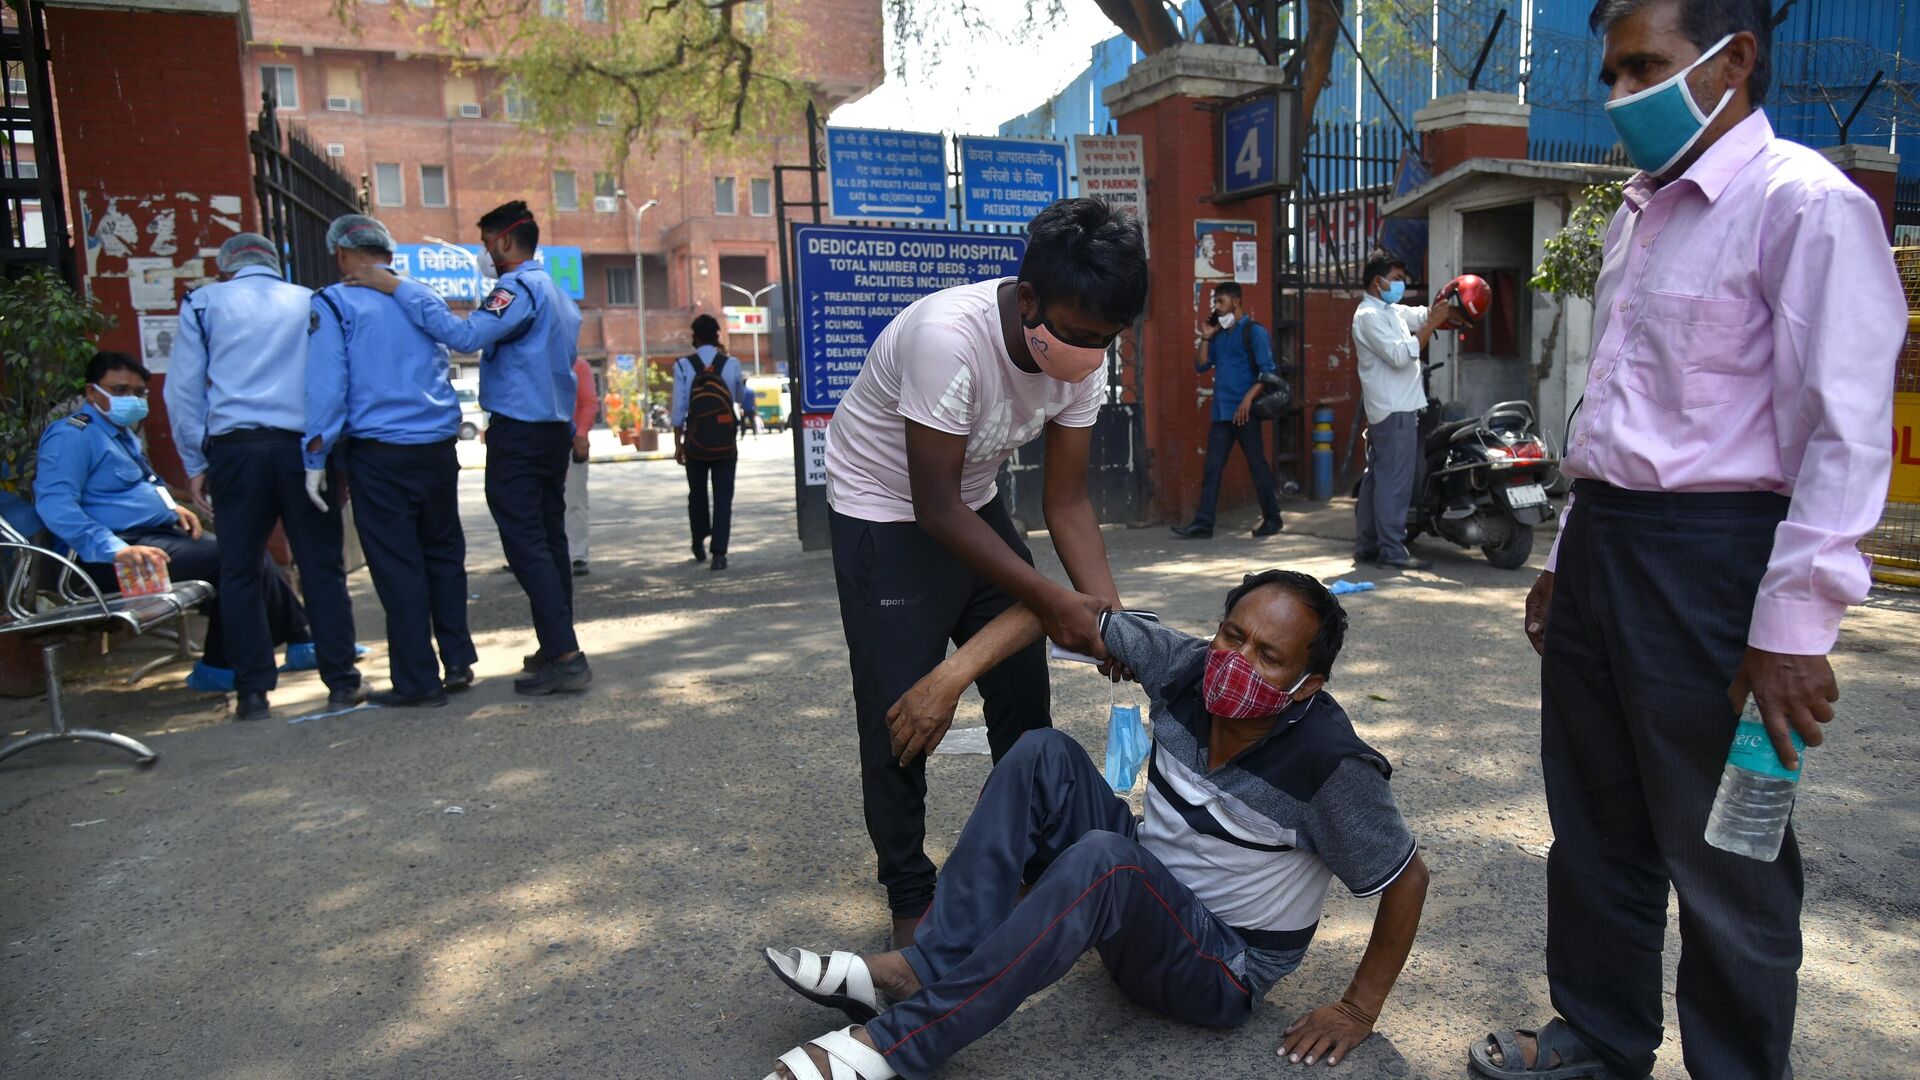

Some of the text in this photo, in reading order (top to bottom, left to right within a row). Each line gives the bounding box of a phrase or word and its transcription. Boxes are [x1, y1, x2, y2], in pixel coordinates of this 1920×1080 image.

[1235, 127, 1262, 180] 4
[836, 179, 849, 188] ALL
[870, 179, 901, 190] PATIENTS
[903, 181, 928, 191] PLEASE
[929, 182, 942, 192] USE
[1088, 180, 1138, 189] NO PARKING
[849, 192, 866, 201] GATE
[916, 193, 937, 204] BLOCK
[971, 188, 1053, 202] WAY TO EMERGENCY
[984, 203, 1021, 216] PATIENTS
[808, 238, 1018, 261] DEDICATED COVID HOSPITAL
[829, 258, 866, 272] TOTAL
[869, 260, 916, 273] NUMBER
[920, 262, 935, 274] OF
[938, 262, 966, 274] BEDS
[978, 264, 1001, 275] 2010
[854, 275, 913, 288] FACILITIES
[824, 292, 876, 302] TREATMENT
[878, 293, 889, 302] OF
[824, 306, 866, 316] PATIENTS
[825, 334, 867, 343] DIALYSIS.
[826, 348, 868, 357] DELIVERY
[827, 362, 862, 371] PLASMA
